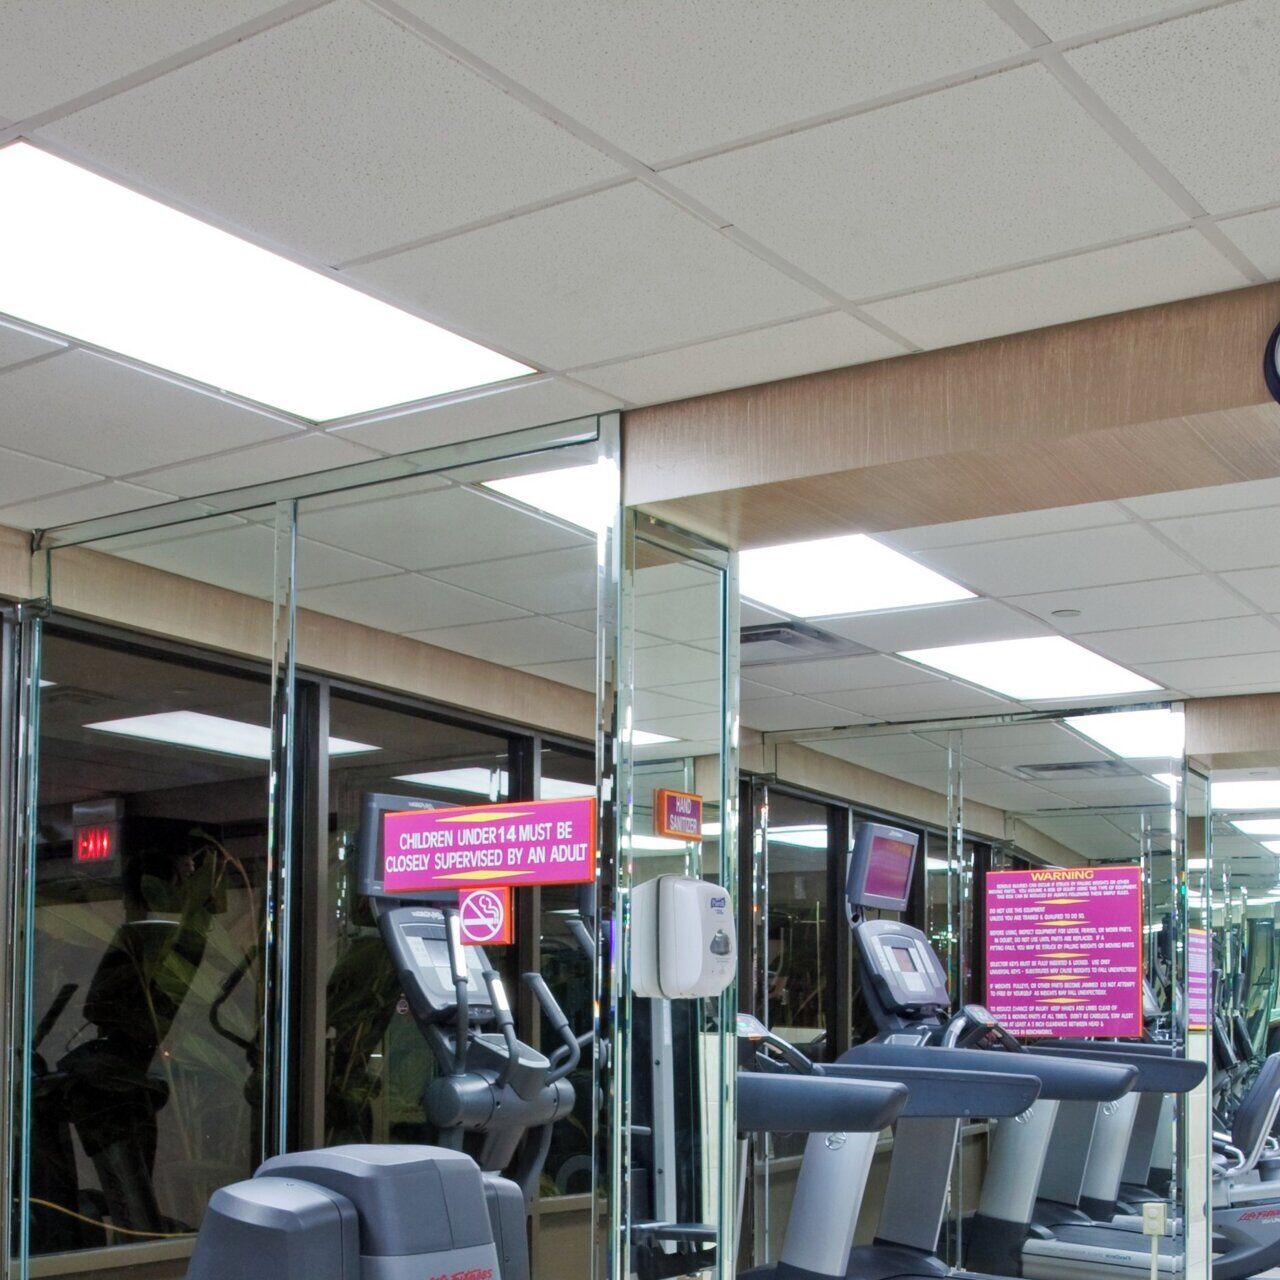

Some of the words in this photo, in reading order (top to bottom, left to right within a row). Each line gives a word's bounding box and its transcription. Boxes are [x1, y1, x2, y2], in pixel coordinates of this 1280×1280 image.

[676, 796, 692, 814] HAND
[670, 814, 697, 833] SANITIZER
[399, 830, 453, 850] CHILDREN
[458, 827, 496, 846] UNDER
[498, 825, 516, 843] 14
[519, 823, 552, 841] MUST
[556, 821, 572, 839] BE
[385, 854, 430, 873] CLOSELY
[434, 850, 502, 870] SUPERVISED
[507, 848, 523, 865] BY
[527, 847, 545, 864] AN
[550, 844, 588, 862] ADULT
[1031, 870, 1094, 881] WARNING
